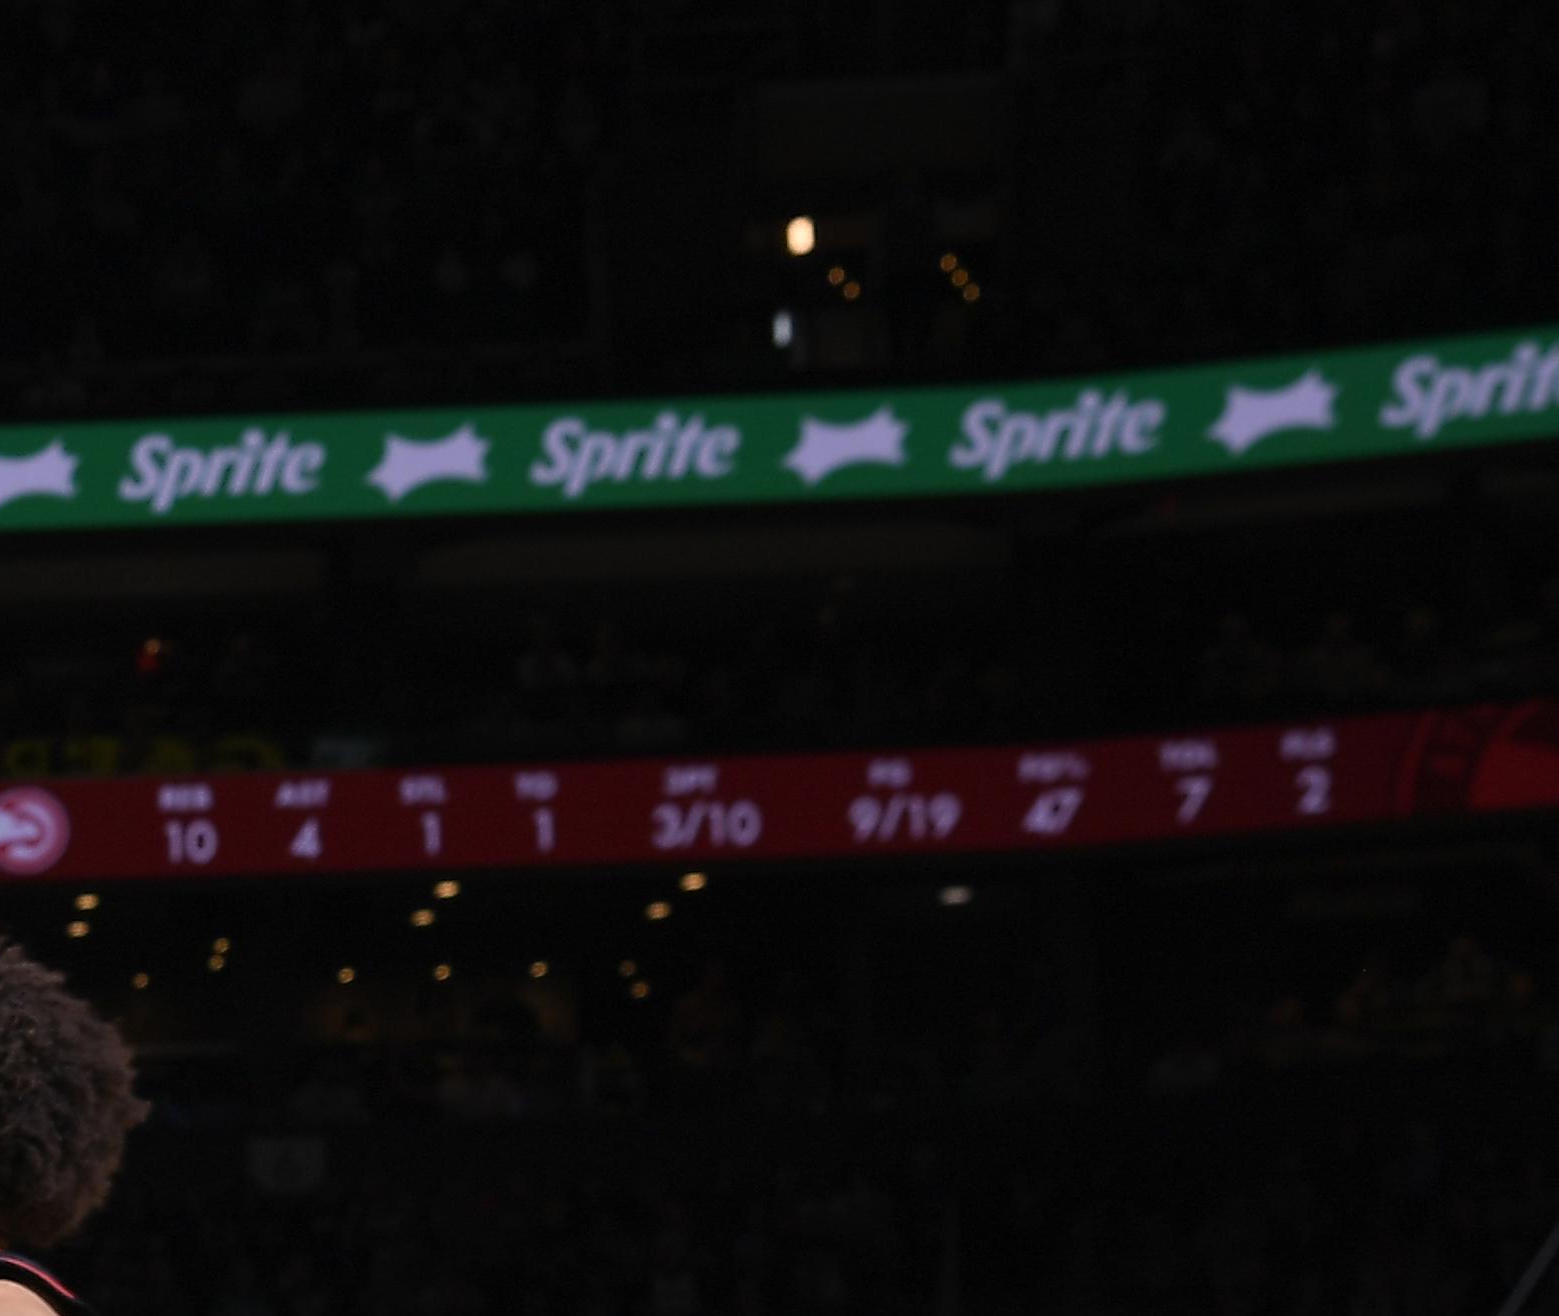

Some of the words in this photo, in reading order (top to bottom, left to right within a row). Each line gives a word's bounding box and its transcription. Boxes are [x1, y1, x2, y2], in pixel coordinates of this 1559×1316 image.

[1379, 337, 1559, 439] Sprit
[118, 428, 325, 514] Sprite
[529, 411, 741, 498] Sprite
[950, 389, 1164, 481] Sprite
[161, 816, 221, 866] 10
[288, 814, 324, 861] 4
[420, 809, 444, 857] 1
[532, 805, 557, 856] 1
[650, 798, 764, 851] 3/10
[847, 790, 964, 844] 9/19
[1174, 773, 1216, 826] 7
[1294, 763, 1334, 817] 2
